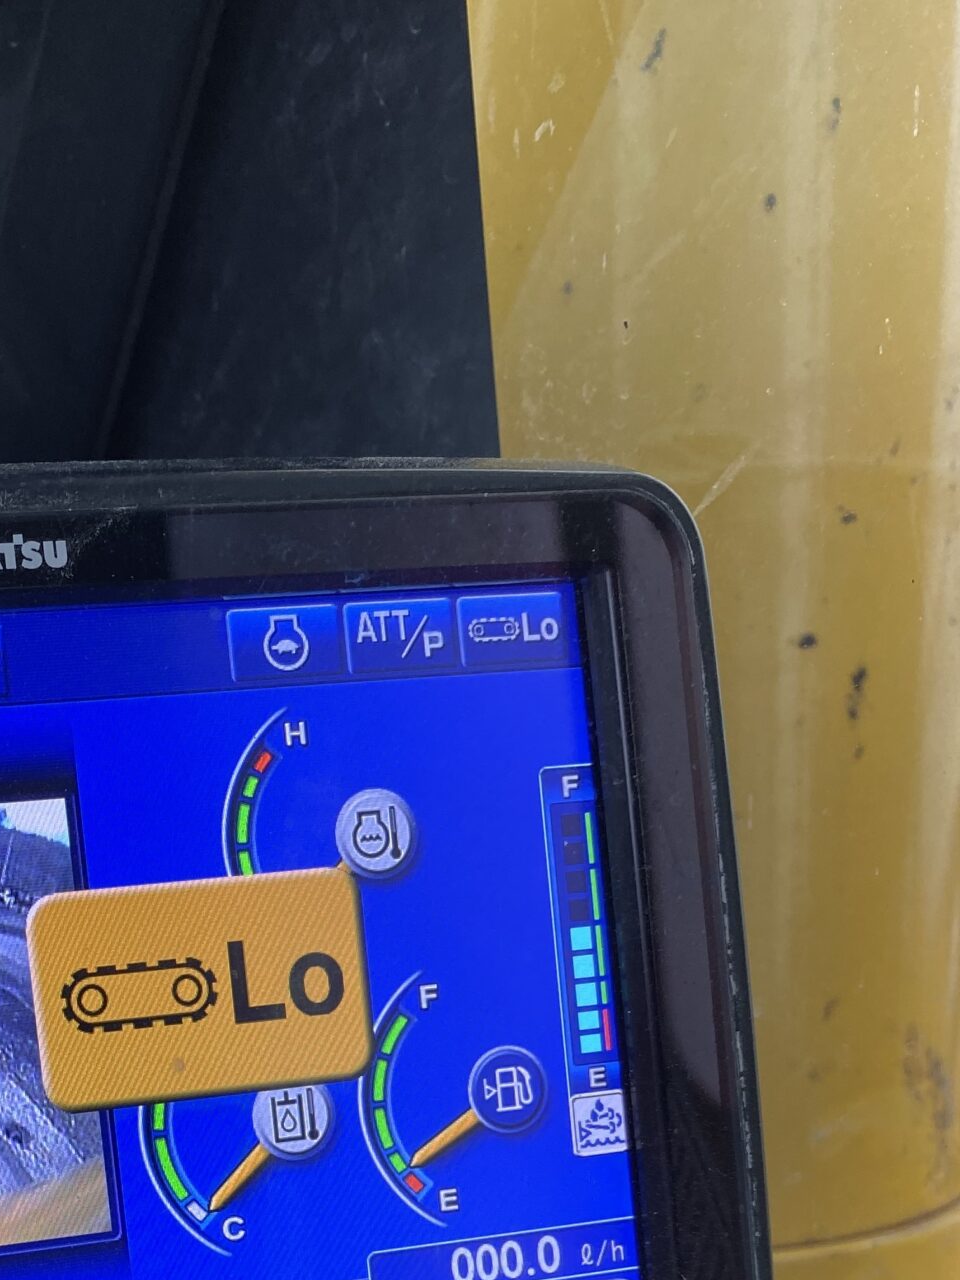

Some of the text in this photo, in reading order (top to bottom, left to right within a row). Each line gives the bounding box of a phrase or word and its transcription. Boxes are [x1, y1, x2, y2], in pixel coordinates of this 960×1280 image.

[356, 609, 444, 658] ATT/P
[521, 610, 560, 645] Lo
[284, 721, 309, 747] H
[560, 774, 581, 800] F
[226, 940, 346, 1026] Lo
[419, 984, 440, 1011] F
[588, 1065, 608, 1089] E
[439, 1188, 460, 1213] E
[222, 1216, 246, 1243] C
